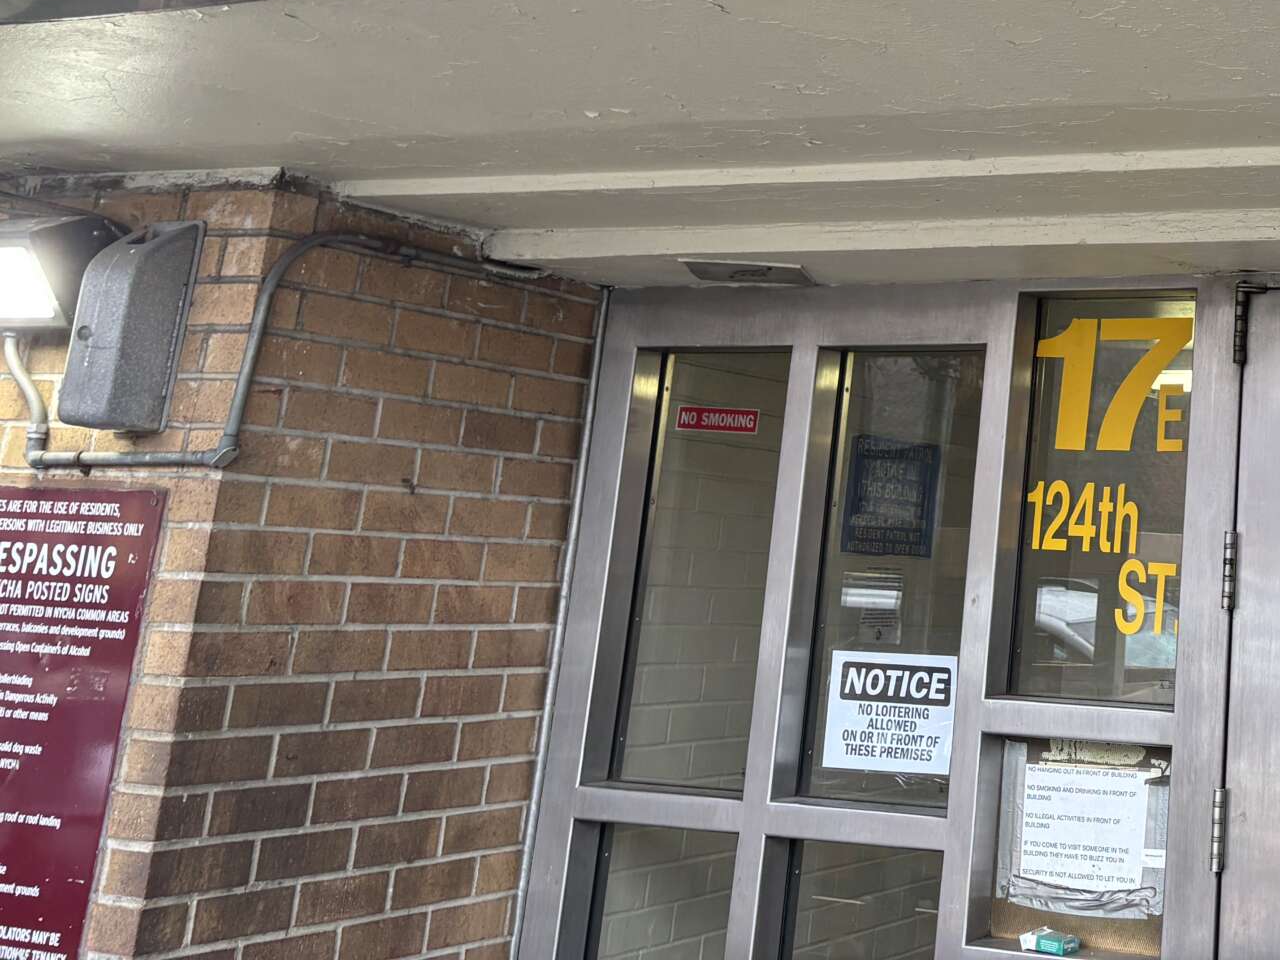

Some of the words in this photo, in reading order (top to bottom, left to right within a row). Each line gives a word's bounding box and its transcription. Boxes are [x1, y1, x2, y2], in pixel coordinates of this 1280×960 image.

[1036, 317, 1193, 452] 17
[1156, 383, 1184, 452] E
[681, 411, 697, 425] NO
[701, 412, 754, 428] SMOKING
[7, 500, 24, 513] ARE
[23, 501, 38, 513] FOR
[39, 501, 53, 514] THE
[54, 502, 68, 514] USE
[69, 502, 80, 514] OF
[80, 503, 121, 518] RESIDENTS,
[1027, 479, 1139, 555] 124th
[27, 519, 46, 532] WITH
[45, 520, 87, 534] LEGITIMATE
[86, 522, 123, 535] BUSINESS
[123, 523, 145, 536] ONLY
[0, 579, 22, 598] CHA
[25, 580, 70, 601] POSTED
[73, 583, 110, 604] SIGNS
[9, 604, 45, 617] PERMITTED
[45, 605, 54, 617] IN
[53, 606, 76, 619] NYCHA
[76, 608, 106, 621] COMMON
[105, 610, 129, 623] AREAS
[49, 625, 61, 635] and
[60, 625, 98, 638] development
[15, 642, 30, 653] Open
[68, 646, 91, 657] Alcohol
[844, 667, 948, 700] NOTICE
[4, 691, 35, 704] Dangerous
[35, 693, 58, 708] Activity
[13, 708, 29, 719] other
[858, 703, 873, 716] NO
[875, 705, 930, 720] LOITERING
[866, 718, 917, 733] ALLOWED
[842, 729, 858, 742] ON
[860, 730, 873, 743] OR
[876, 732, 888, 744] IN
[890, 733, 925, 748] FRONT
[925, 735, 941, 749] OF
[12, 742, 24, 756] dog
[25, 744, 42, 755] waste
[844, 743, 877, 758] THESE
[879, 747, 933, 762] PREMISES
[1037, 767, 1062, 775] HANGING
[1111, 771, 1138, 779] BUILDING
[1036, 785, 1062, 793] SMOKING
[1074, 787, 1101, 796] DRINKING
[1109, 790, 1128, 798] FRONT
[5, 811, 18, 823] roof
[25, 813, 39, 825] roof
[39, 814, 61, 830] landing
[1024, 821, 1050, 829] BUILDING
[1034, 813, 1056, 821] ILLEGAL
[1056, 814, 1085, 823] ACTIVITIES
[1093, 816, 1112, 824] FRONT
[1042, 841, 1058, 849] COME
[1068, 843, 1081, 851] VISIT
[1082, 845, 1110, 853] SOMEONE
[1049, 851, 1063, 859] THEY
[1089, 854, 1104, 862] BUZZ
[1022, 868, 1047, 876] SECURITY
[1067, 872, 1094, 881] ALLOWED
[1116, 876, 1128, 884] YOU
[15, 885, 40, 897] grounds
[31, 929, 49, 944] MAY
[48, 932, 61, 947] BE
